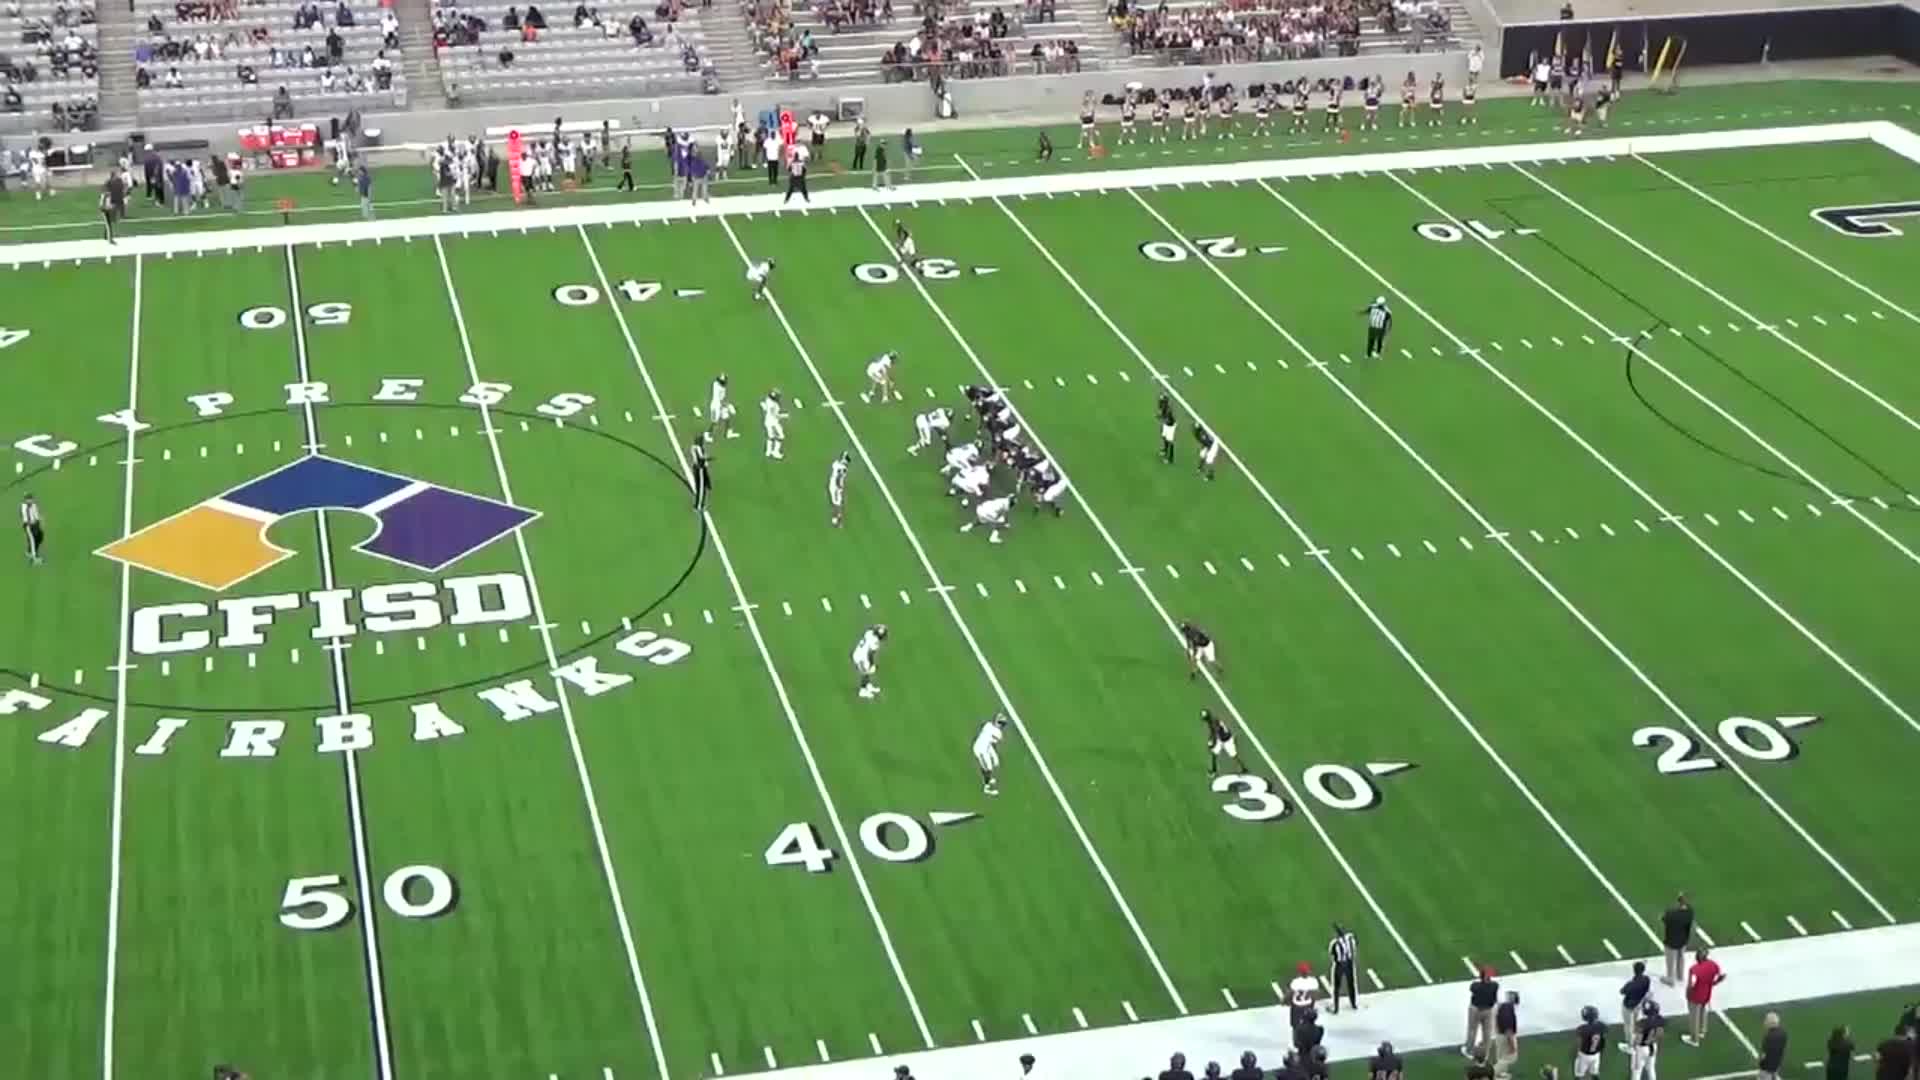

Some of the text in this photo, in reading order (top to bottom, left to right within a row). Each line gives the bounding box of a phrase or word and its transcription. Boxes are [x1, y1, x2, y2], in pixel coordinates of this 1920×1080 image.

[1141, 236, 1247, 263] 20
[1416, 219, 1505, 243] 10
[553, 279, 662, 305] 40
[855, 258, 960, 284] 30
[241, 302, 352, 329] 50
[14, 379, 595, 457] CYPRESS
[131, 573, 533, 655] CFISD
[0, 630, 691, 757] FAIRBANKS
[1632, 716, 1792, 774] 20
[1211, 763, 1375, 820] 30
[764, 812, 930, 873] 40
[279, 864, 454, 929] 50
